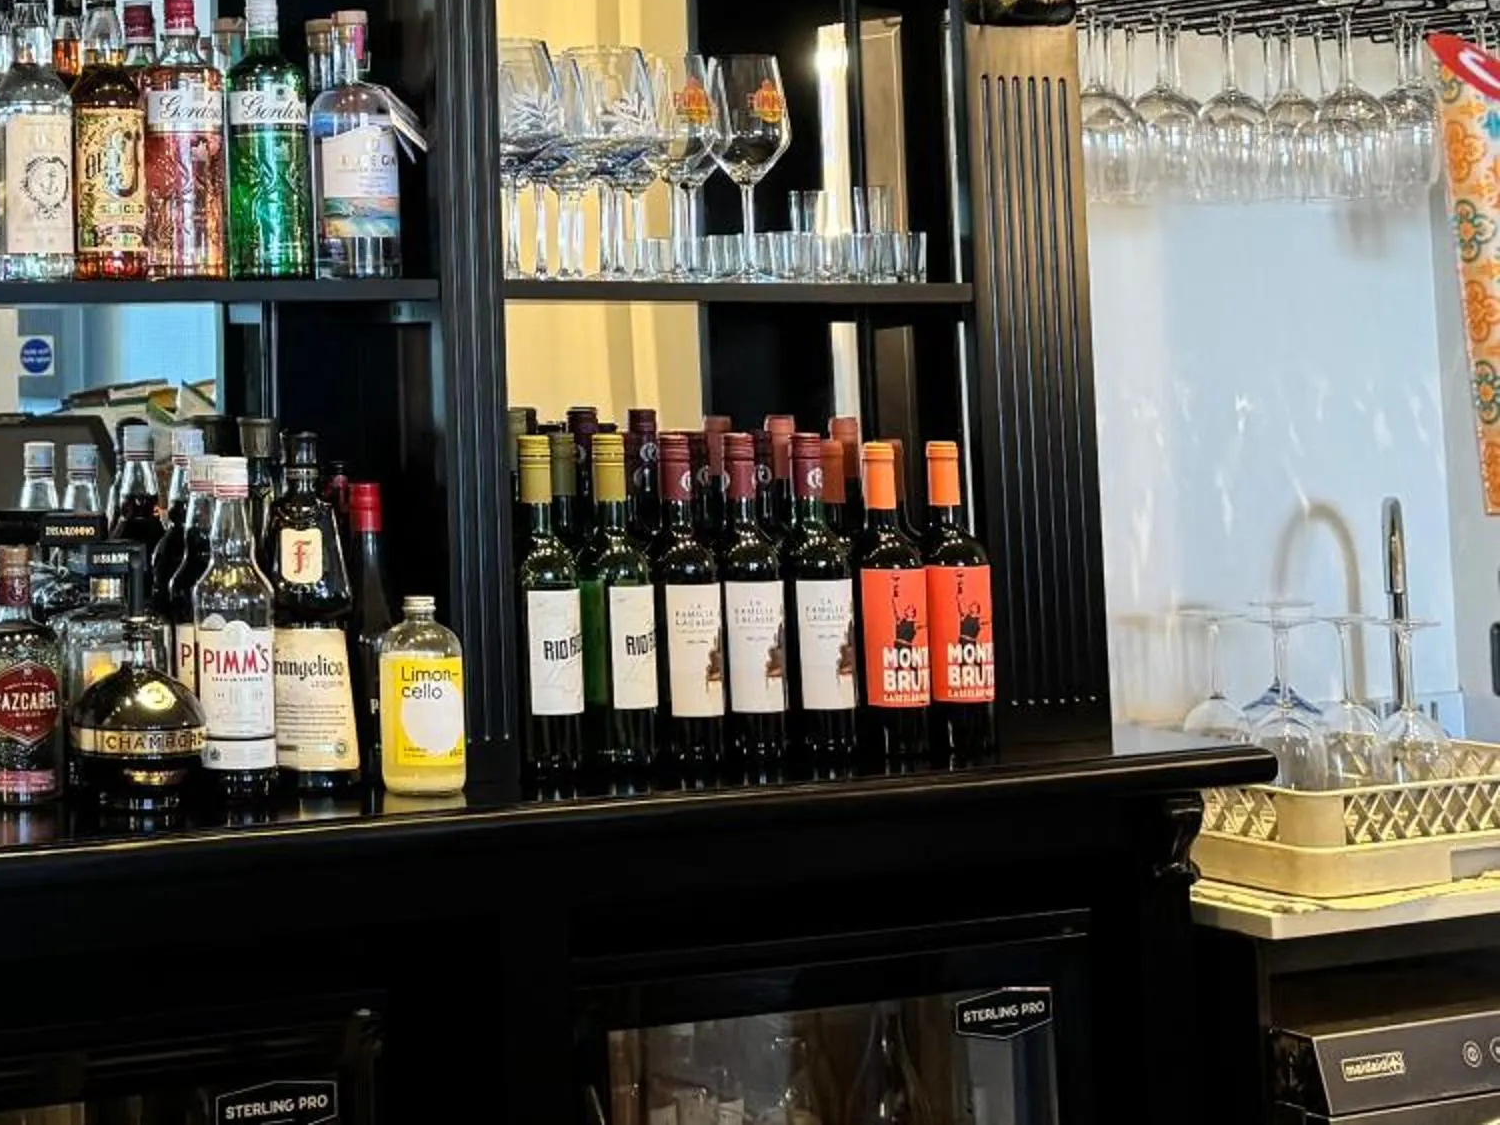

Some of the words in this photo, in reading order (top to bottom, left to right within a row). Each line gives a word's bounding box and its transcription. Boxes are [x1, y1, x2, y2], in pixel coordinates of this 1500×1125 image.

[160, 94, 221, 119] Gordo
[242, 94, 305, 119] Gordo
[203, 644, 269, 674] PIMM'S
[883, 646, 929, 668] MONT
[947, 642, 994, 664] MONT
[273, 655, 344, 681] rangelico
[401, 666, 460, 682] Limon-
[947, 664, 995, 687] BRUT
[401, 683, 443, 699] cello
[883, 668, 930, 692] BRUT
[963, 1004, 1018, 1023] STERLING
[1021, 1000, 1045, 1015] PRO
[225, 1098, 295, 1120] STERLING
[298, 1094, 328, 1110] PRO
